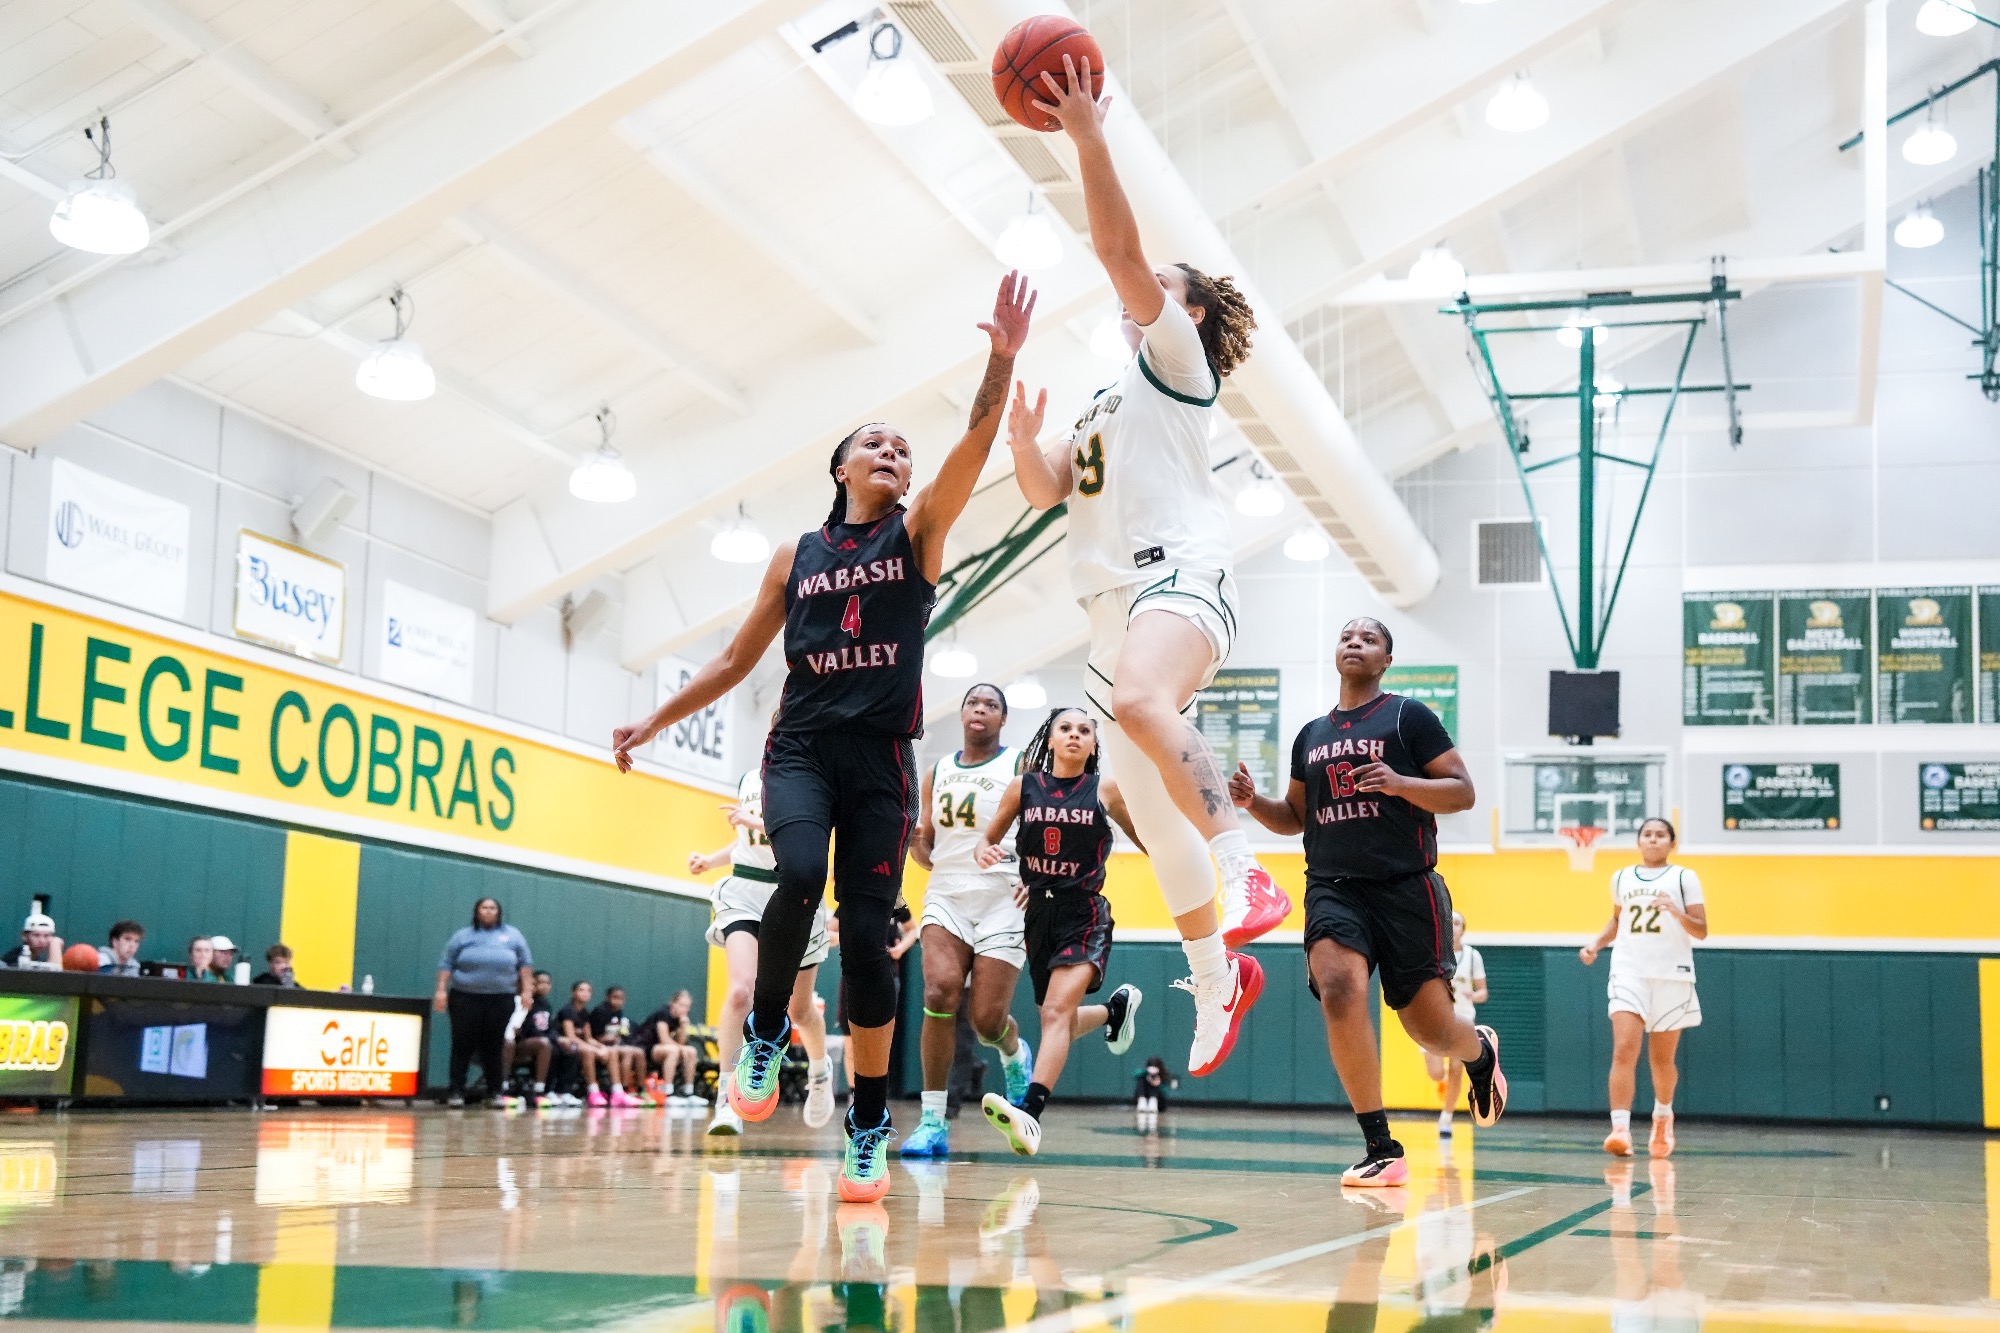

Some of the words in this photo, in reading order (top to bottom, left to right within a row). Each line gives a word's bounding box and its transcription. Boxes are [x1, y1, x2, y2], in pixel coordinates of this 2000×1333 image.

[88, 513, 129, 546] WARE
[797, 556, 905, 599] WABASH
[249, 555, 335, 640] Busey
[840, 594, 862, 639] 4
[805, 642, 899, 675] VALLEY
[1787, 638, 1864, 651] BASKETBALL
[675, 713, 724, 760] SOLE
[1308, 739, 1385, 765] WABASH
[270, 690, 517, 832] COBRAS
[1325, 761, 1356, 799] 13
[1756, 776, 1833, 790] BASKETBALL
[938, 791, 977, 829] 34
[1024, 806, 1095, 825] WABASH
[1316, 801, 1381, 825] VALLEY
[1043, 826, 1062, 856] 8
[1026, 855, 1081, 877] VALLEY
[1629, 904, 1662, 934] 22
[320, 1020, 389, 1067] Carle
[291, 1071, 337, 1091] SPORTS
[338, 1072, 392, 1092] MEDICINE
